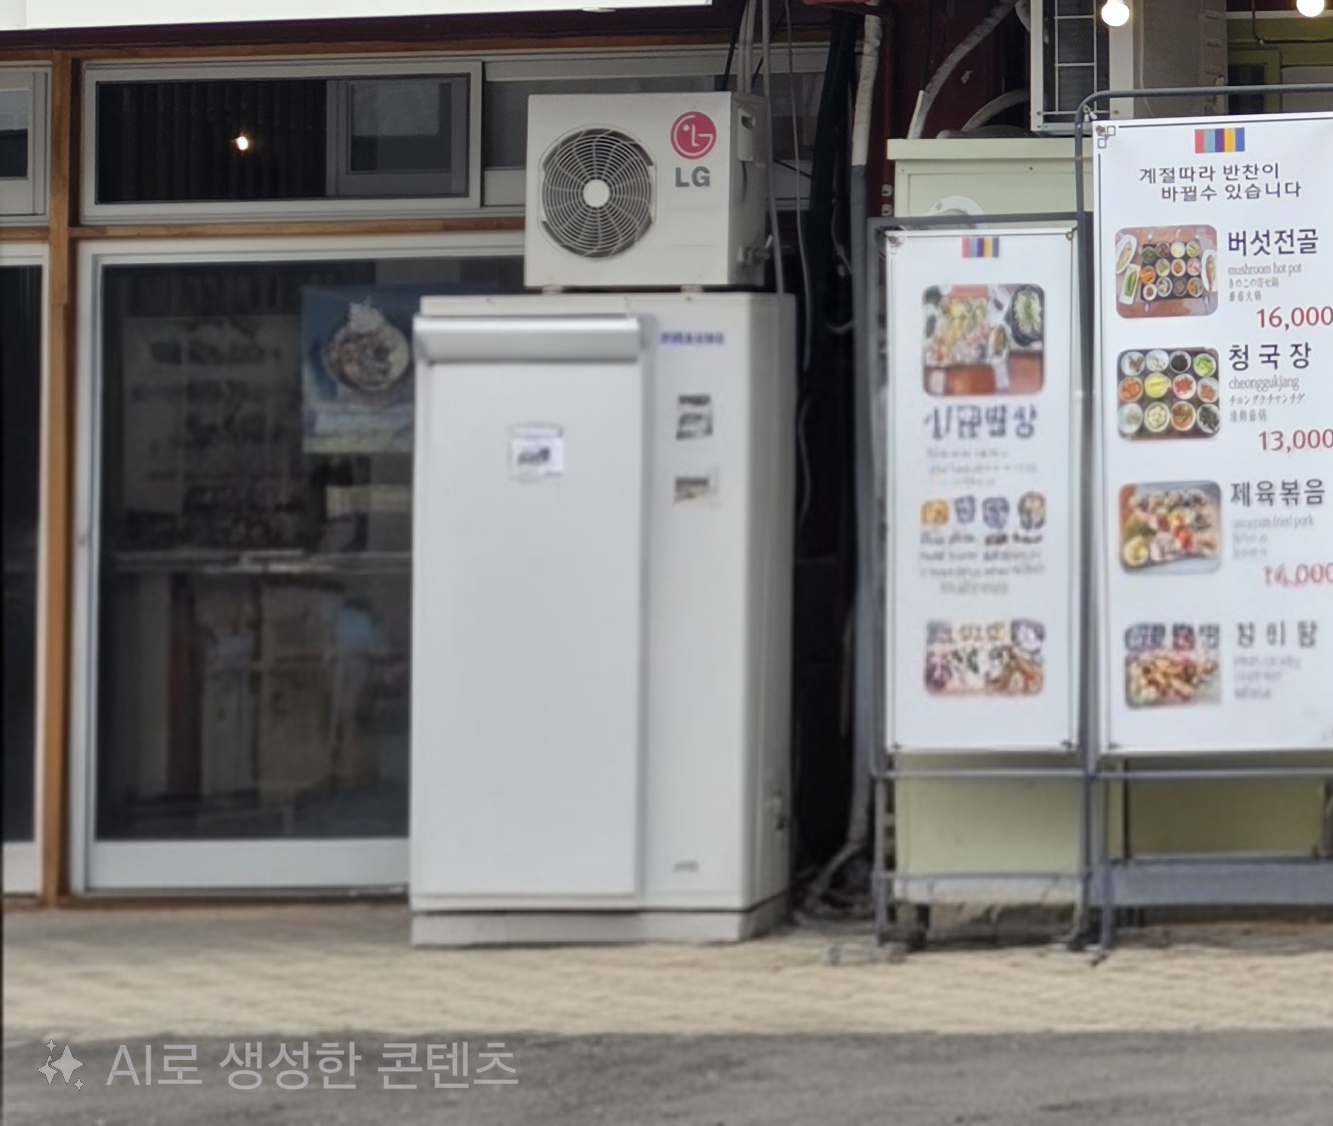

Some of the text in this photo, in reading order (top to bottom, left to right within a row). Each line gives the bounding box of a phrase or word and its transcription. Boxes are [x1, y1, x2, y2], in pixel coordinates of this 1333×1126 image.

[674, 166, 711, 189] LG
[1139, 162, 1279, 184] 계절따라 반찬이
[1224, 181, 1303, 201] 있습니다
[1227, 228, 1319, 257] 버섯전골
[1228, 261, 1302, 277] mushroom hot pot
[1228, 341, 1312, 372] 청국장
[1230, 478, 1326, 508] 제육볶음
